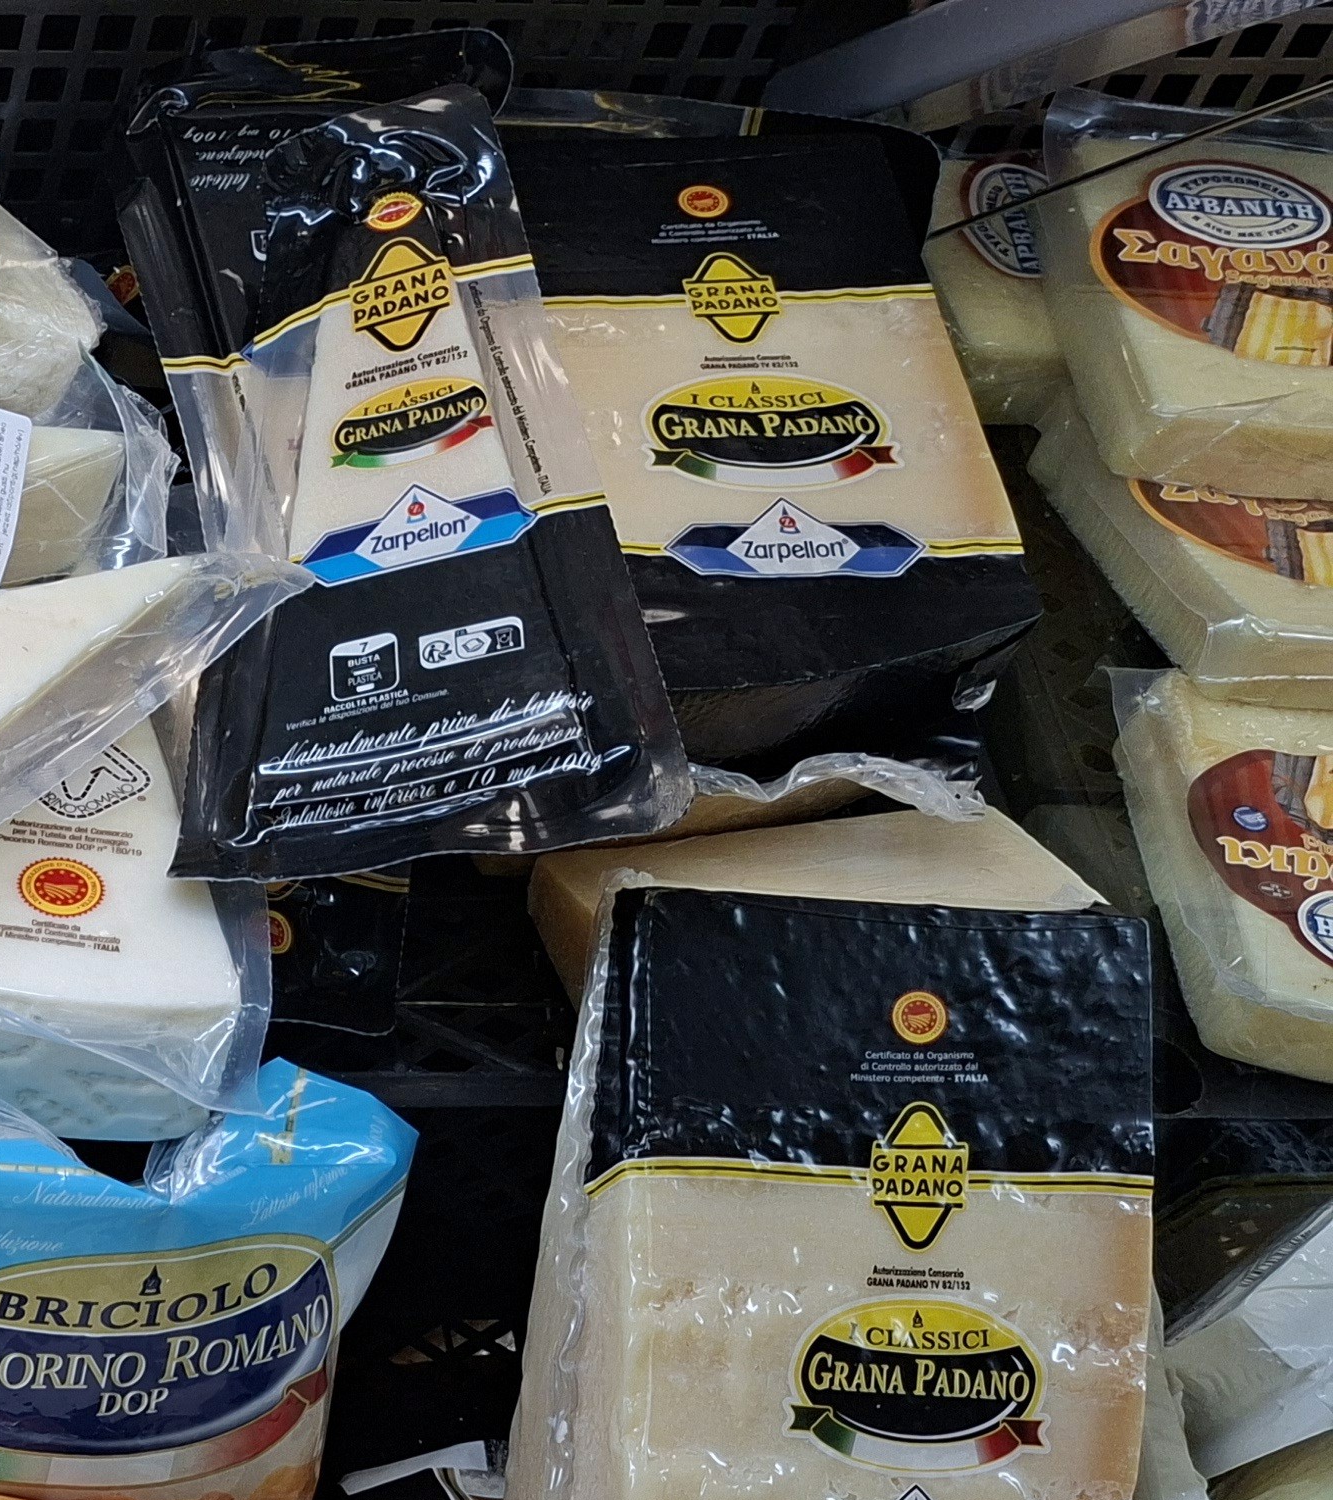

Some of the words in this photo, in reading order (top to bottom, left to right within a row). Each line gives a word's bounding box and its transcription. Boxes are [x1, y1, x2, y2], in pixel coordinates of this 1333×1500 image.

[353, 268, 447, 305] GRANA
[688, 284, 773, 299] GRANA
[353, 286, 450, 325] PADANO
[691, 297, 778, 311] PADANO
[345, 376, 377, 390] GRANA
[374, 384, 455, 415] CLASSICI
[708, 390, 827, 409] CLASSICI
[339, 418, 403, 447] GRANA
[407, 396, 484, 429] PADANO
[658, 413, 751, 441] GRANA
[758, 412, 876, 439] PADANO
[370, 515, 468, 555] Zarpellon
[741, 539, 846, 564] Zarpellon
[347, 653, 381, 667] BUSTA
[324, 697, 367, 714] RACCOLTA
[369, 689, 409, 705] PLASTICA
[270, 725, 417, 770] Naturalmente
[420, 711, 479, 747] privo
[490, 698, 514, 723] di
[271, 785, 303, 808] per
[312, 765, 382, 792] naturale
[383, 750, 456, 783] processo
[464, 739, 486, 761] di
[865, 1051, 911, 1060] Certificato
[926, 1051, 974, 1062] Organismo
[871, 1062, 911, 1071] Controllo
[850, 1073, 890, 1082] Ministero
[954, 1073, 988, 1083] ITALIA
[872, 1154, 964, 1174] GRANA
[872, 1178, 964, 1198] PADANO
[866, 1277, 894, 1288] GRANA
[895, 1278, 929, 1289] PADANO
[162, 1294, 331, 1384] ROMANO
[866, 1327, 990, 1350] CLASSICI
[808, 1351, 906, 1395] GRANA
[913, 1358, 1031, 1402] PADANO
[96, 1387, 169, 1418] DOP
